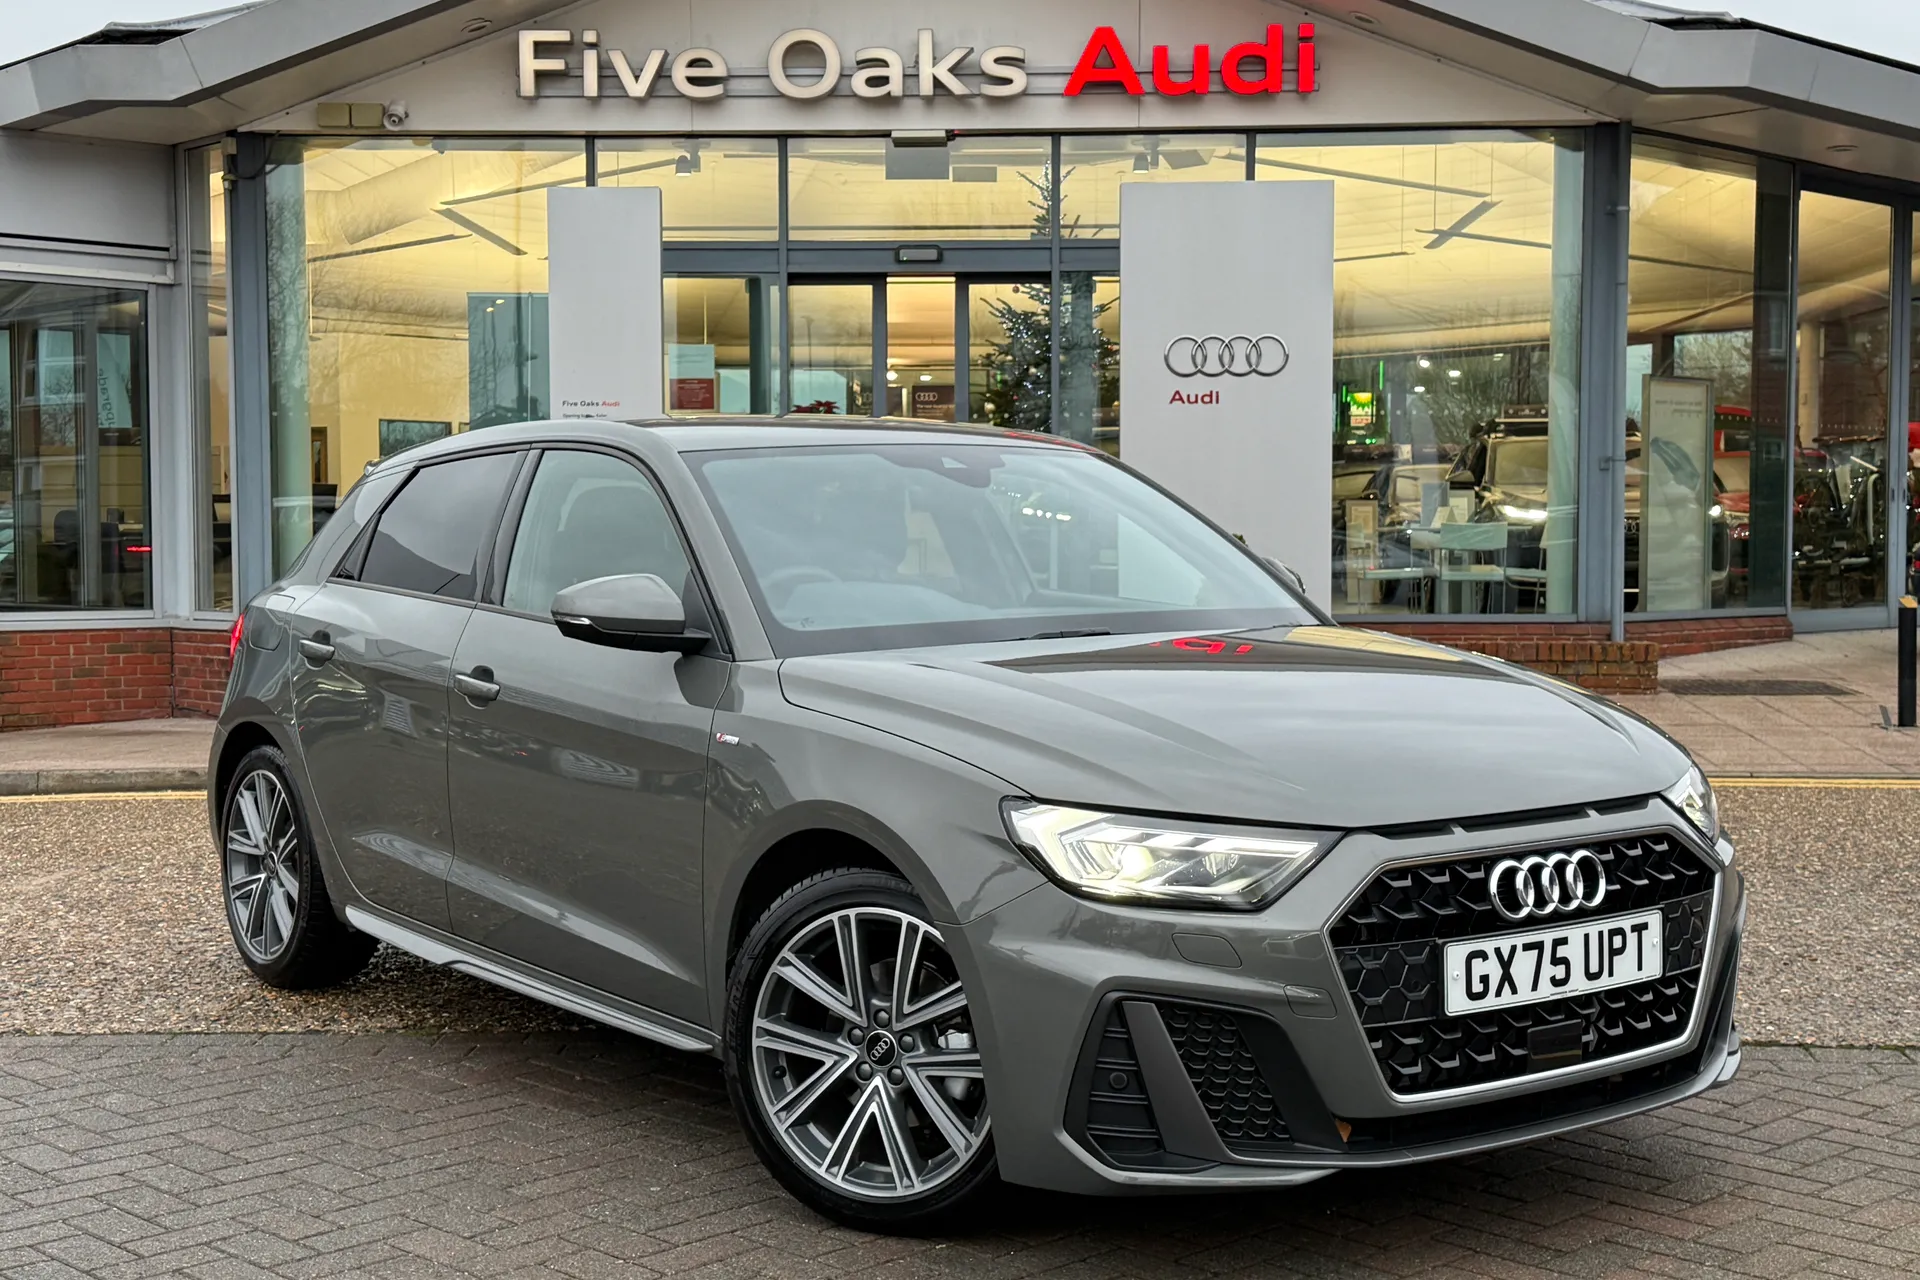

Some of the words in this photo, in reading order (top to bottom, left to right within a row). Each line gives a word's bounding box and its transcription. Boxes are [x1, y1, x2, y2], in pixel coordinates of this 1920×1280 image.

[518, 29, 730, 99] Five
[767, 28, 1029, 99] Oaks
[1063, 23, 1316, 96] Audi
[561, 400, 579, 408] Five
[580, 400, 600, 408] Oaks
[601, 400, 621, 408] Audi
[1168, 389, 1221, 405] Audi
[1465, 935, 1572, 1002] GX75
[1583, 921, 1649, 982] UPT
